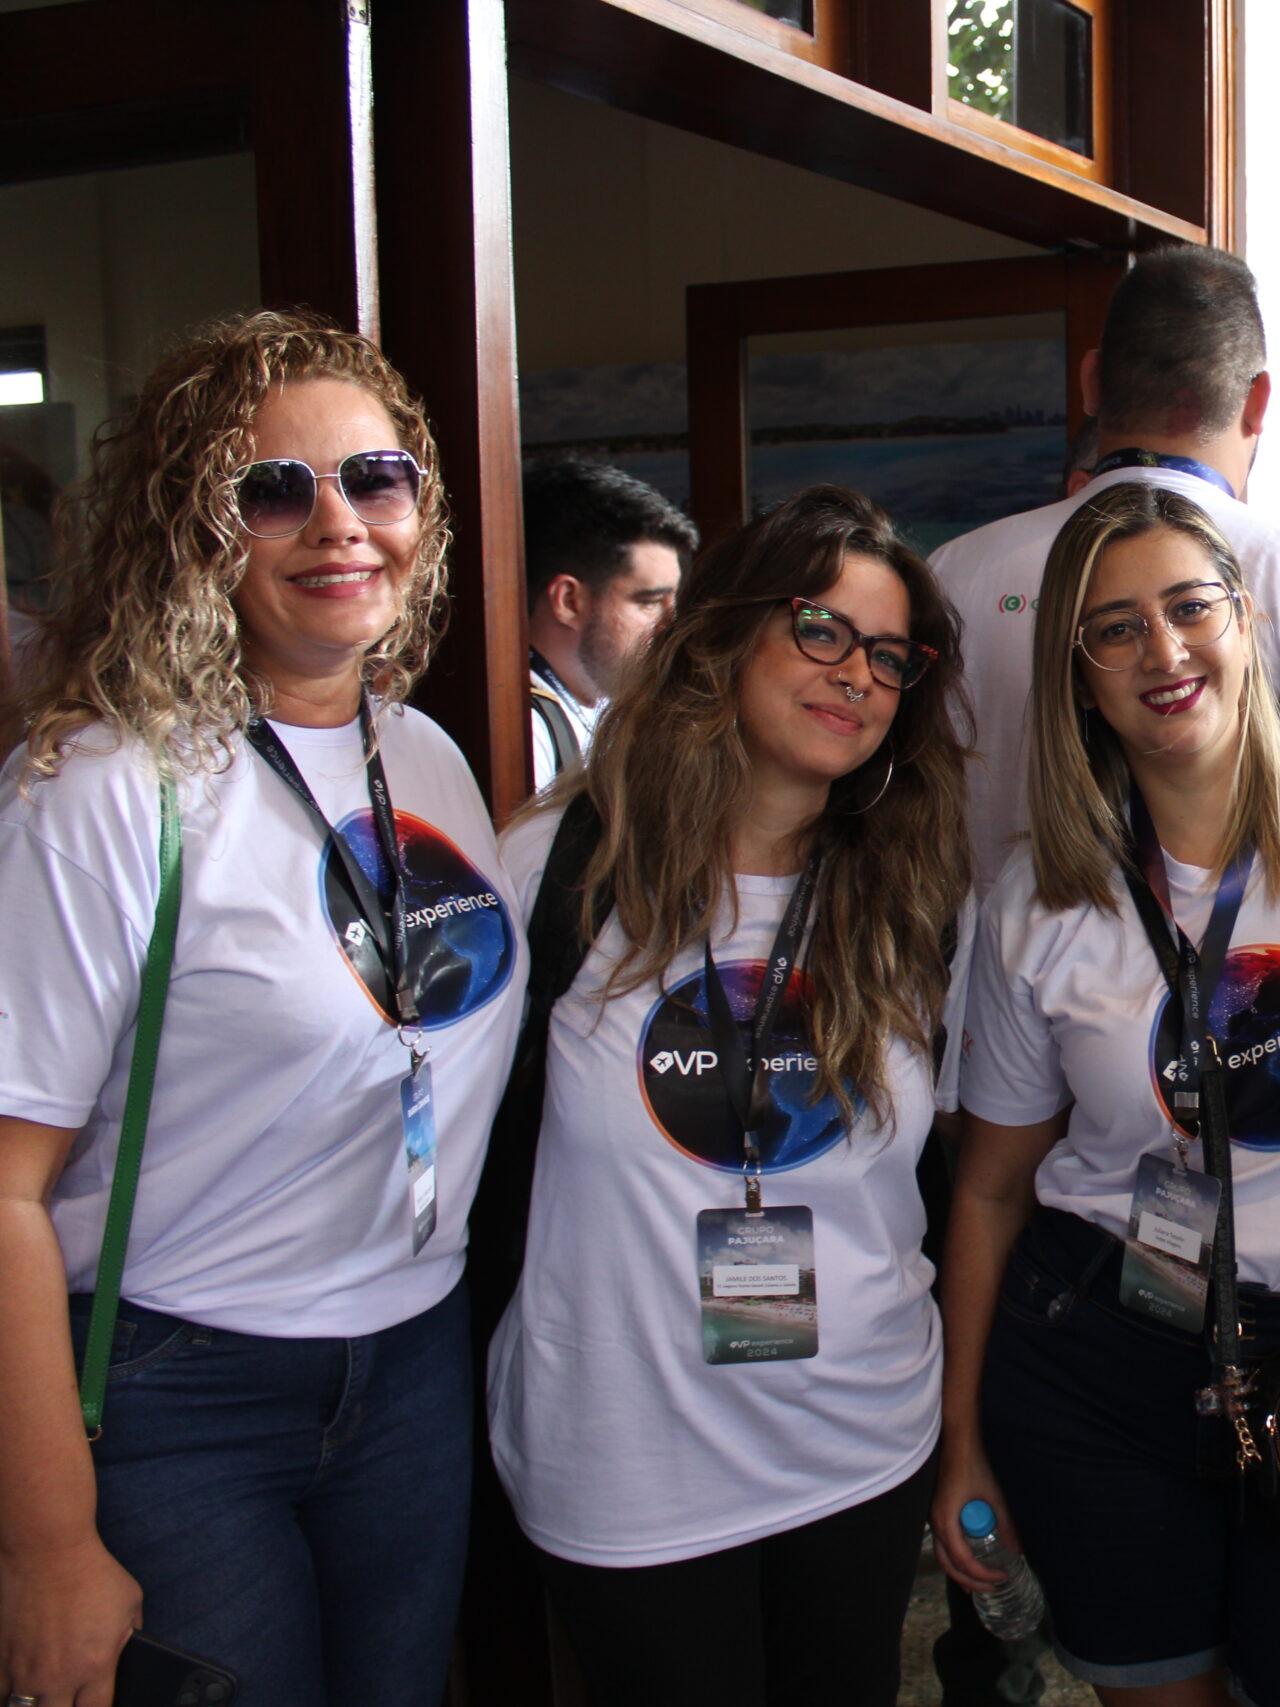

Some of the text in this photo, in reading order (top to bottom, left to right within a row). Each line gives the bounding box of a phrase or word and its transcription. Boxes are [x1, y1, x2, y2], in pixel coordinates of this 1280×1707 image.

[404, 892, 498, 928] experience
[754, 967, 787, 1039] VP experience
[673, 1050, 719, 1075] VP
[737, 1225, 775, 1236] GRUPO
[746, 1347, 778, 1358] 2024
